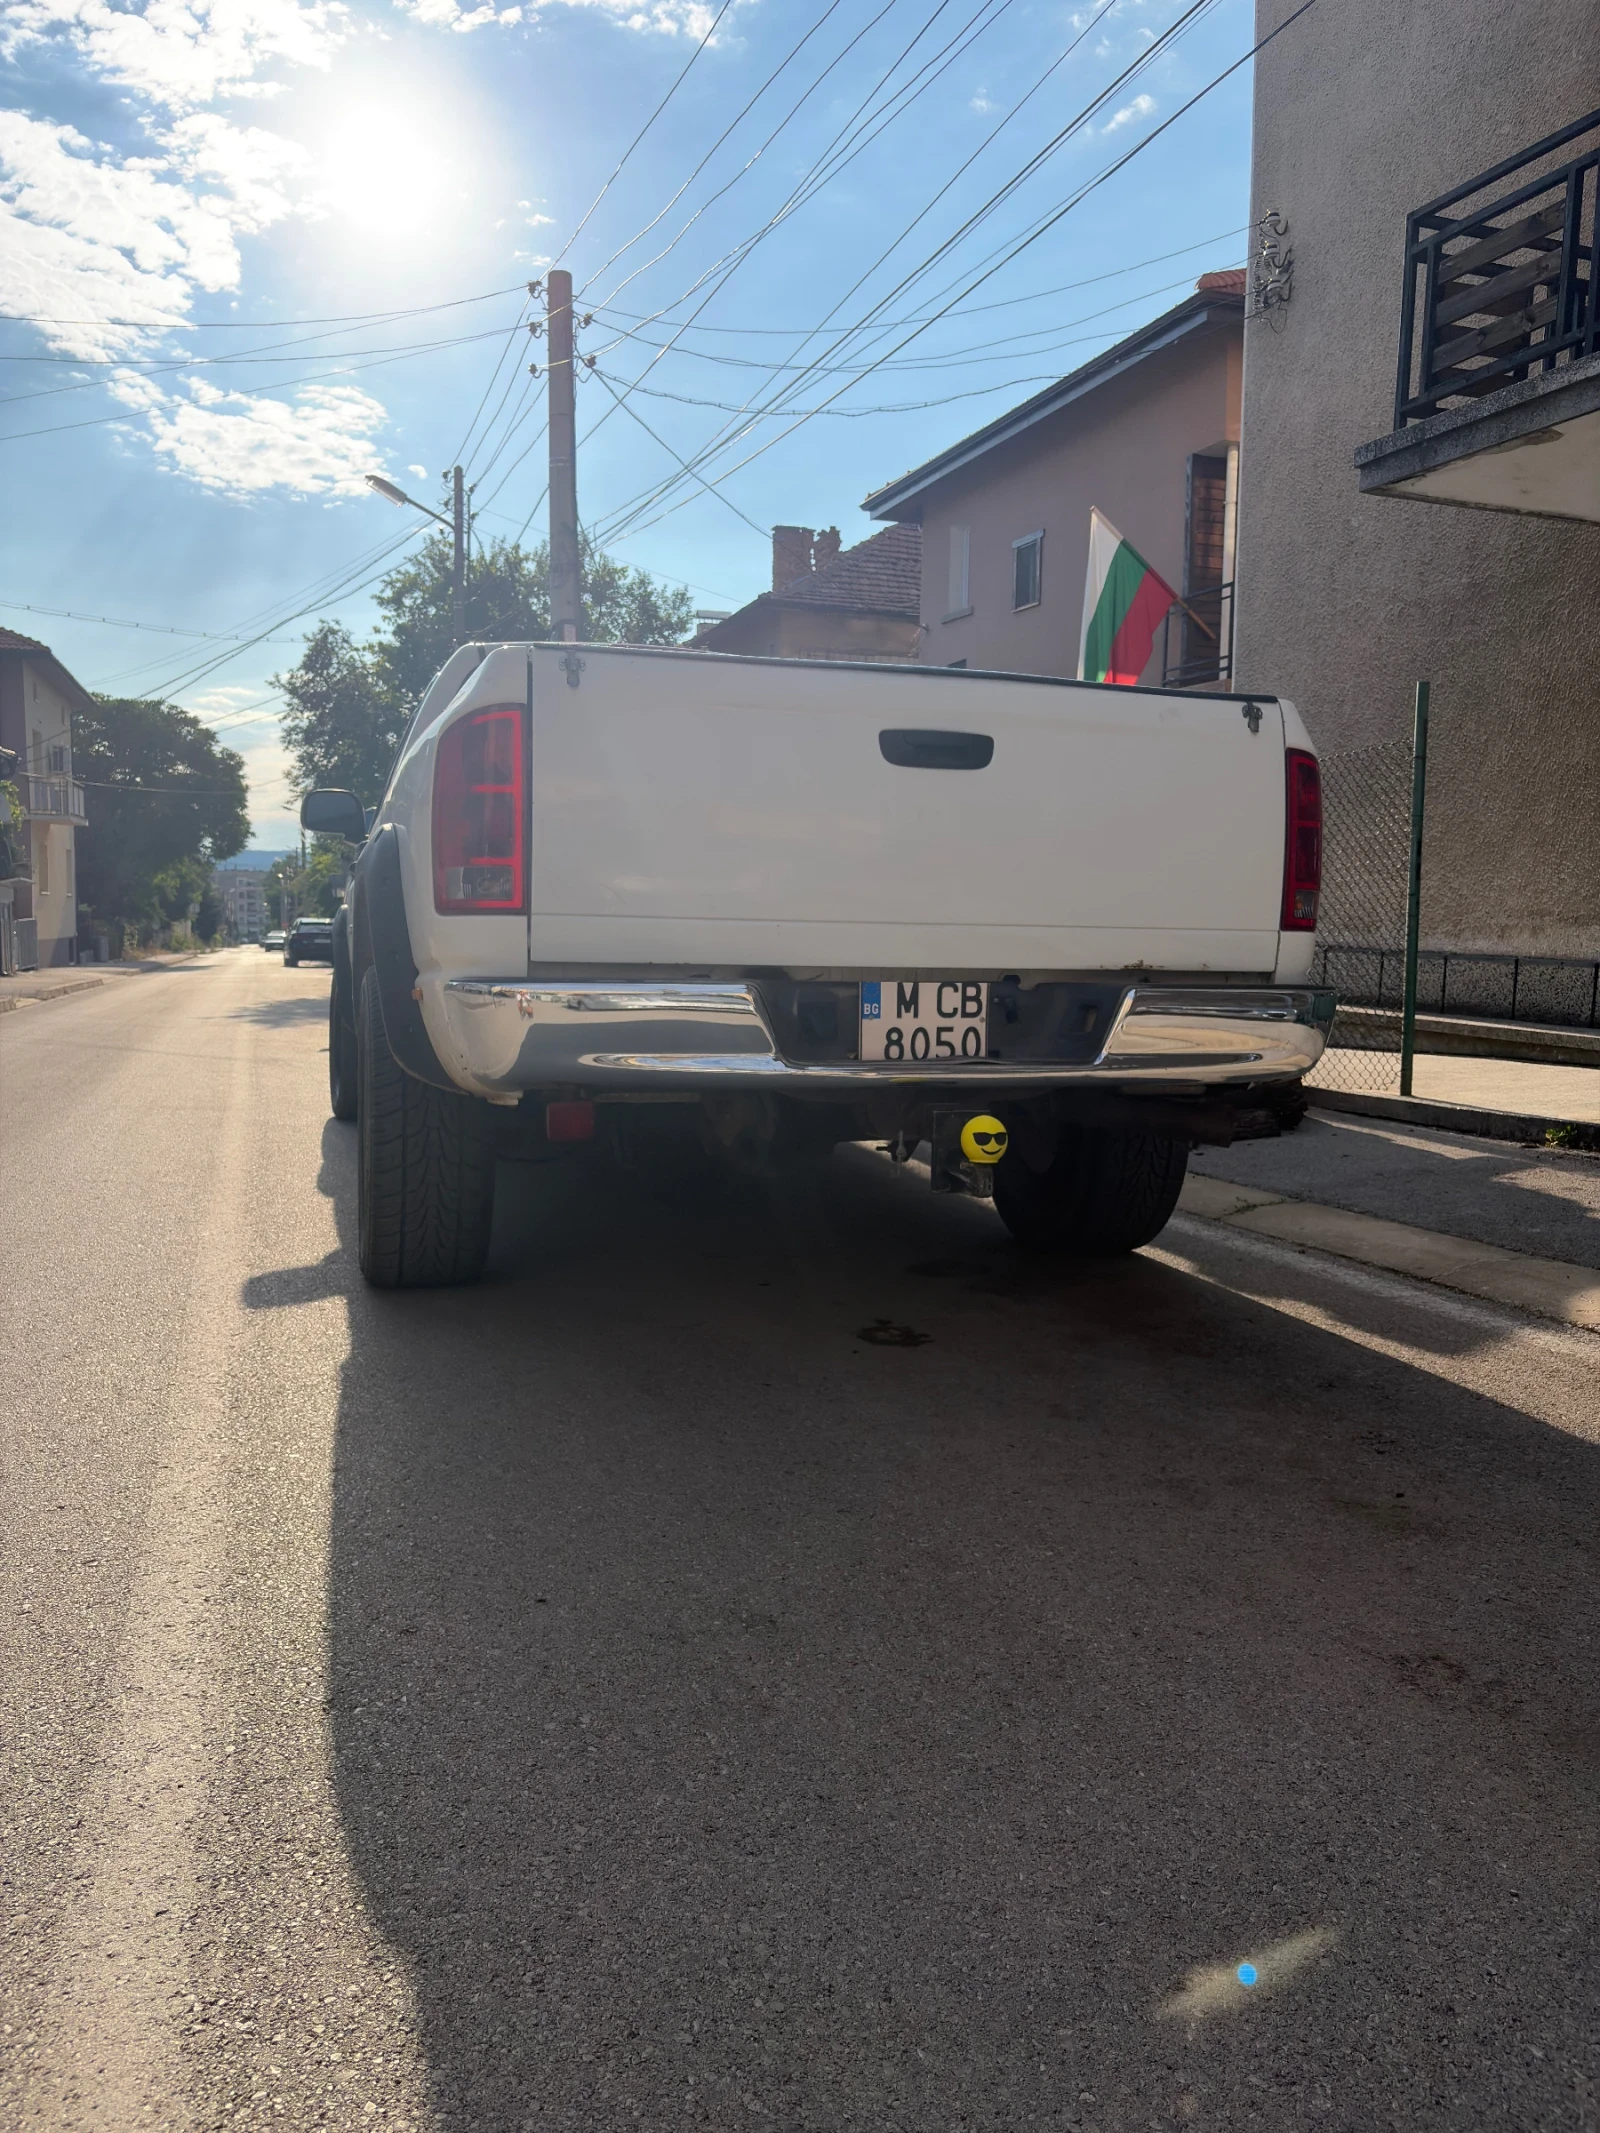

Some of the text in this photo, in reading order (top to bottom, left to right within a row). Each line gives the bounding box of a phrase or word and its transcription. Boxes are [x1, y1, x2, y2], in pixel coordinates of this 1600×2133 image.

[864, 1003, 879, 1014] BG
[897, 982, 983, 1018] M CB
[884, 1026, 981, 1060] 8050
